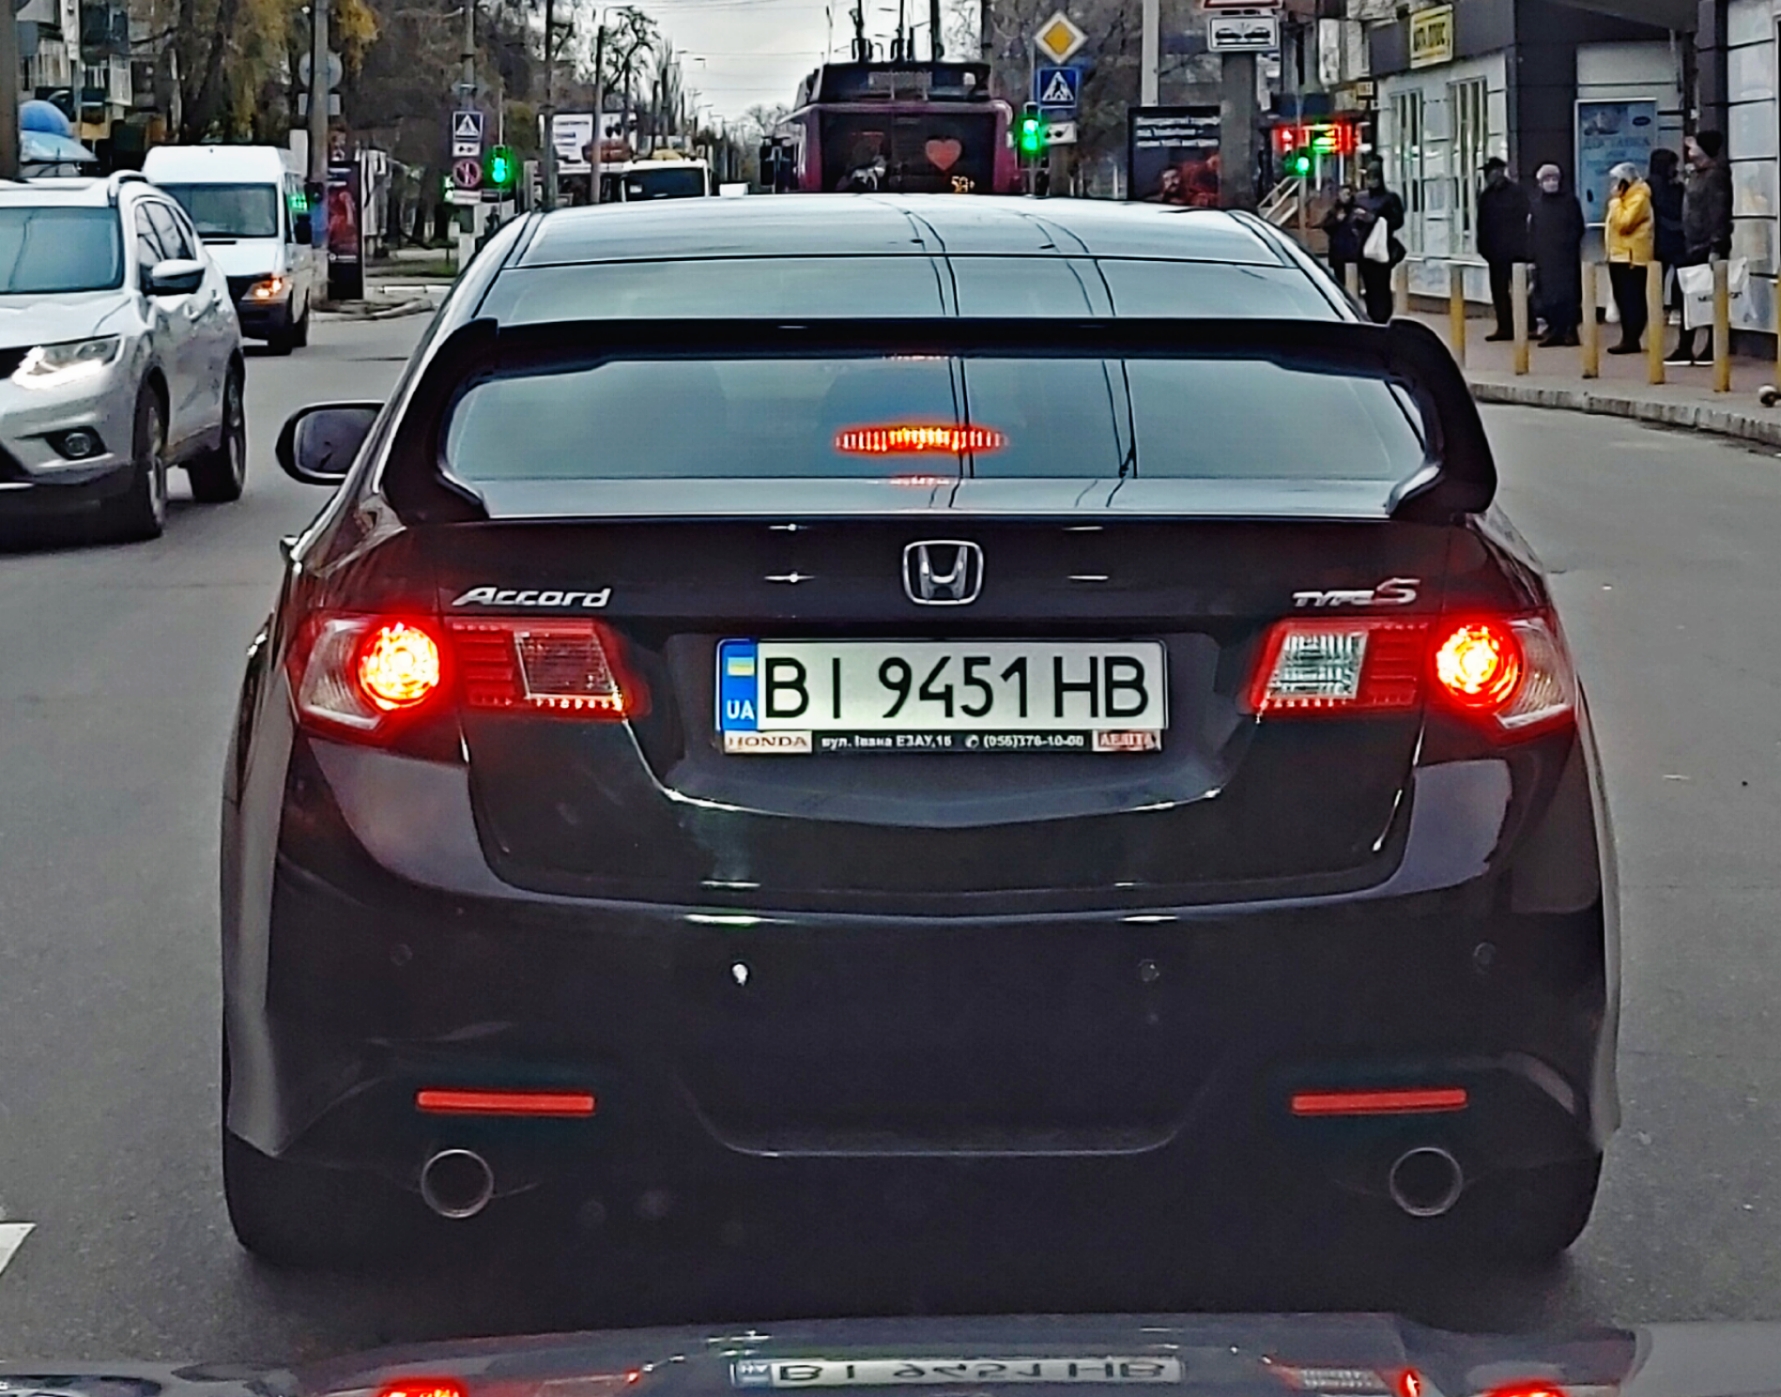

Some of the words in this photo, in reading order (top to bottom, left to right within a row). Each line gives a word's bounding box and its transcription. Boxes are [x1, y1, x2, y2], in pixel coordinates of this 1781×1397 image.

[452, 586, 612, 608] Accord
[1375, 577, 1421, 606] S
[764, 656, 841, 719] BI
[878, 656, 1028, 719] 9451
[1054, 656, 1149, 719] HB
[727, 700, 755, 720] UA
[728, 735, 807, 748] HONDA
